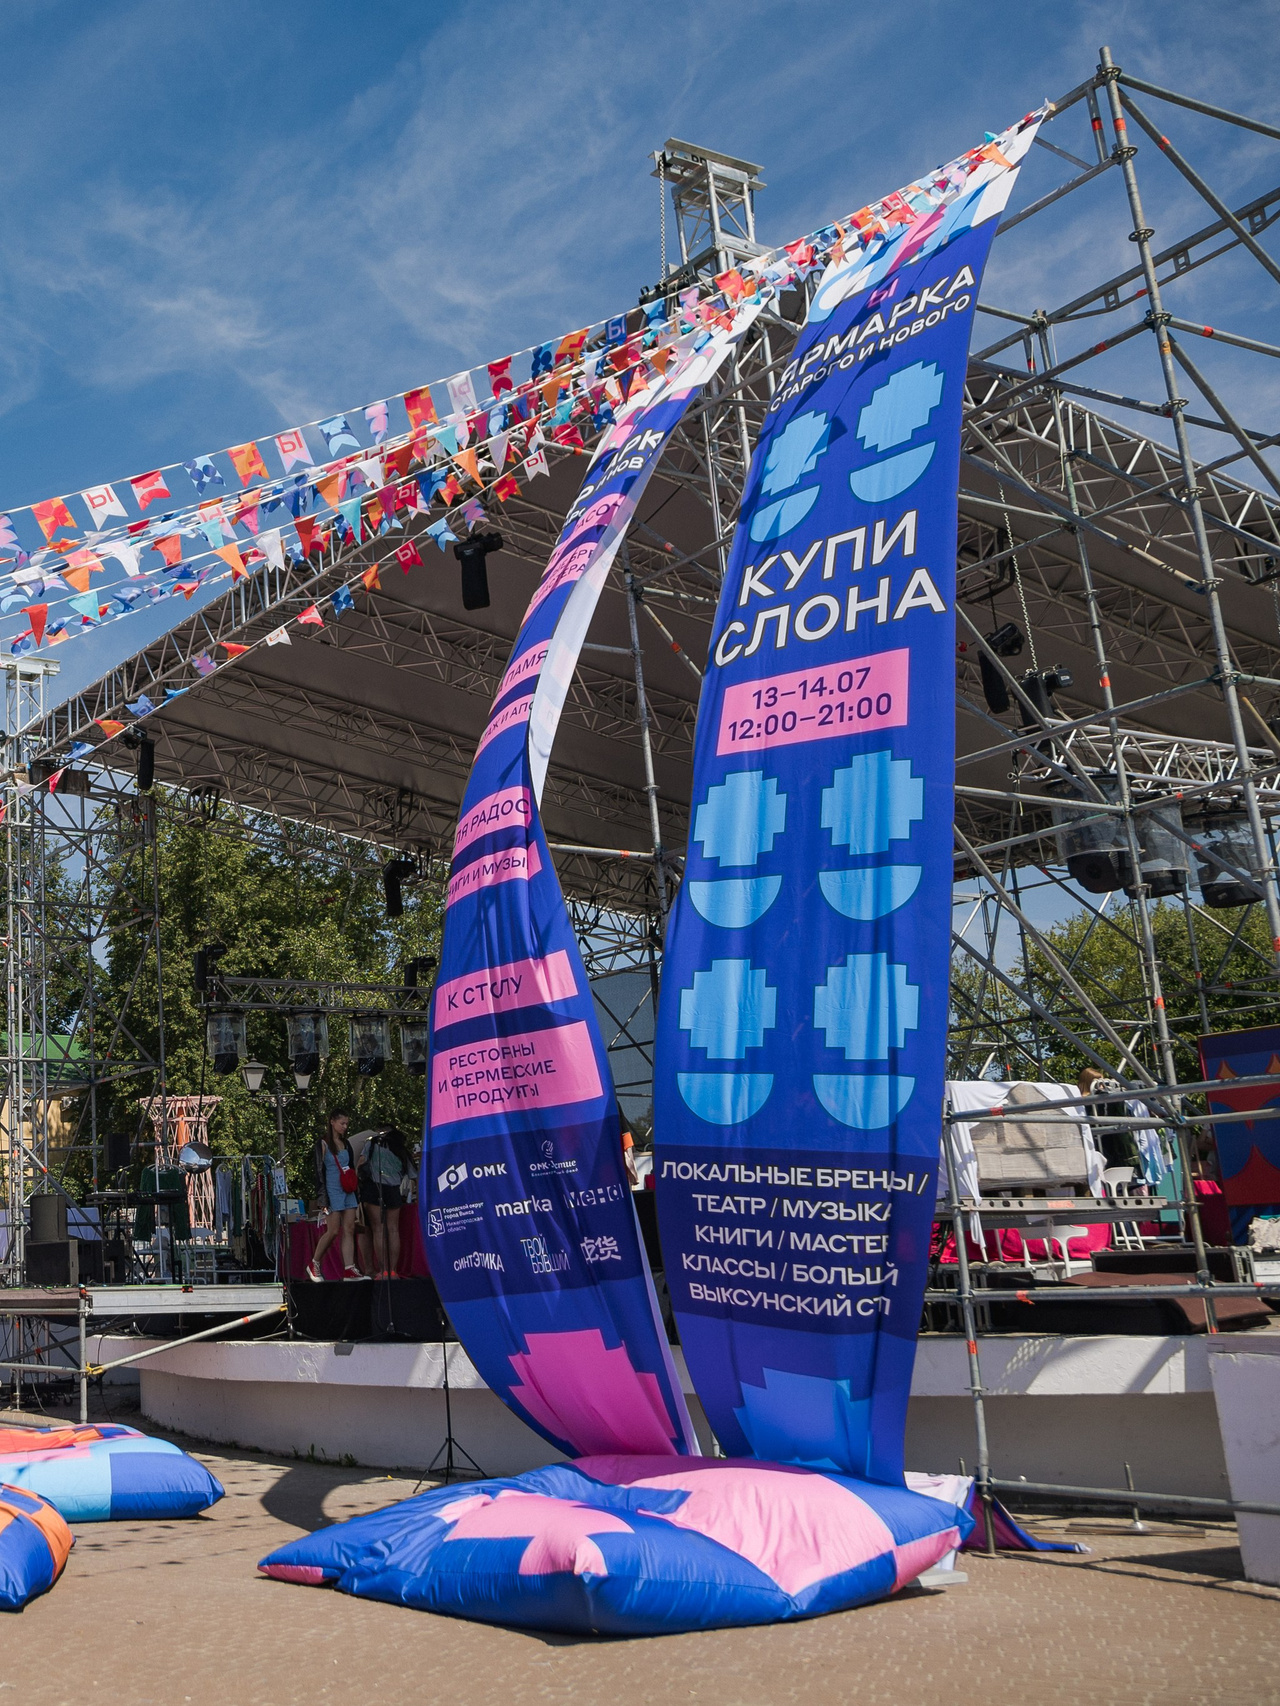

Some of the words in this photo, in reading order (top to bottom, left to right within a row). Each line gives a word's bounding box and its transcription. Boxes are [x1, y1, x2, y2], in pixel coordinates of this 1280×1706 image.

[777, 266, 975, 392] ЯРМАРКА
[770, 354, 855, 412] СТАРОГО
[858, 343, 875, 361] И
[879, 295, 970, 351] НОВОГО
[739, 510, 917, 606] КУПИ
[715, 569, 946, 667] СЛОНА
[470, 798, 530, 832] РАДОС
[482, 856, 526, 876] МУЗЫ
[448, 992, 459, 1011] К
[438, 1080, 448, 1093] И
[661, 1161, 813, 1187] ЛОКАЛЬНЫЕ
[692, 1194, 766, 1217] ТЕАТР
[695, 1225, 773, 1249] КНИГИ
[682, 1253, 776, 1280] КЛАССЫ
[689, 1283, 852, 1317] ВЫКСУНСКИЙ
